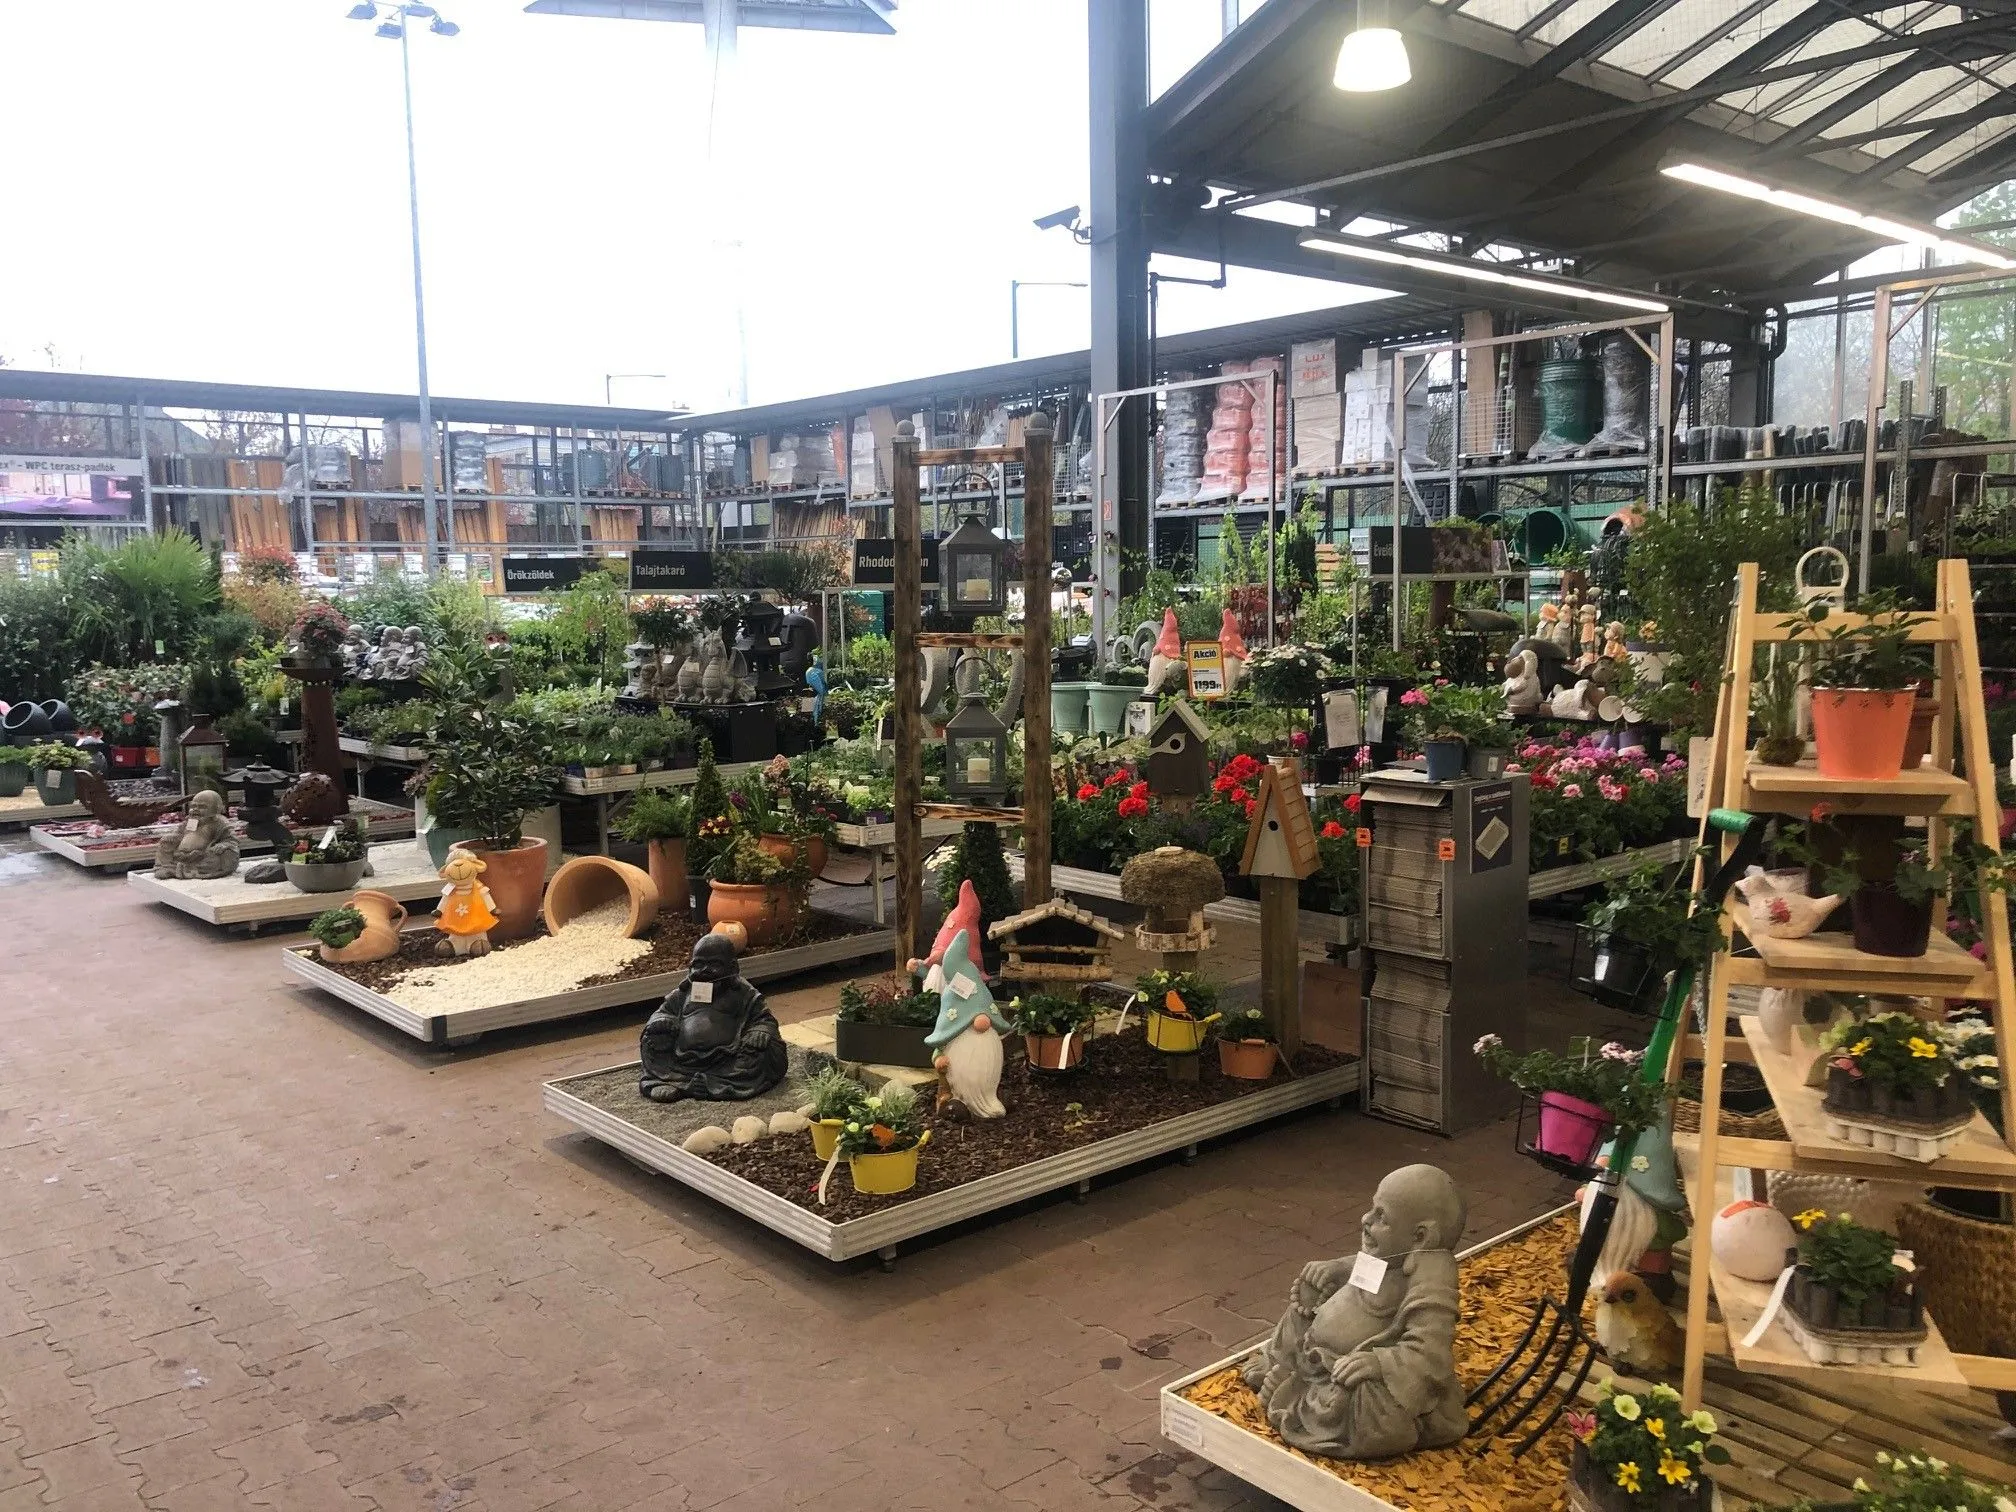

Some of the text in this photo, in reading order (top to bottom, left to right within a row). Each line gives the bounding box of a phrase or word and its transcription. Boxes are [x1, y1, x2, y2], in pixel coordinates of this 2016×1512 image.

[25, 461, 48, 470] WPC
[858, 553, 929, 568] Rhododn
[635, 564, 686, 578] Talajtakaró
